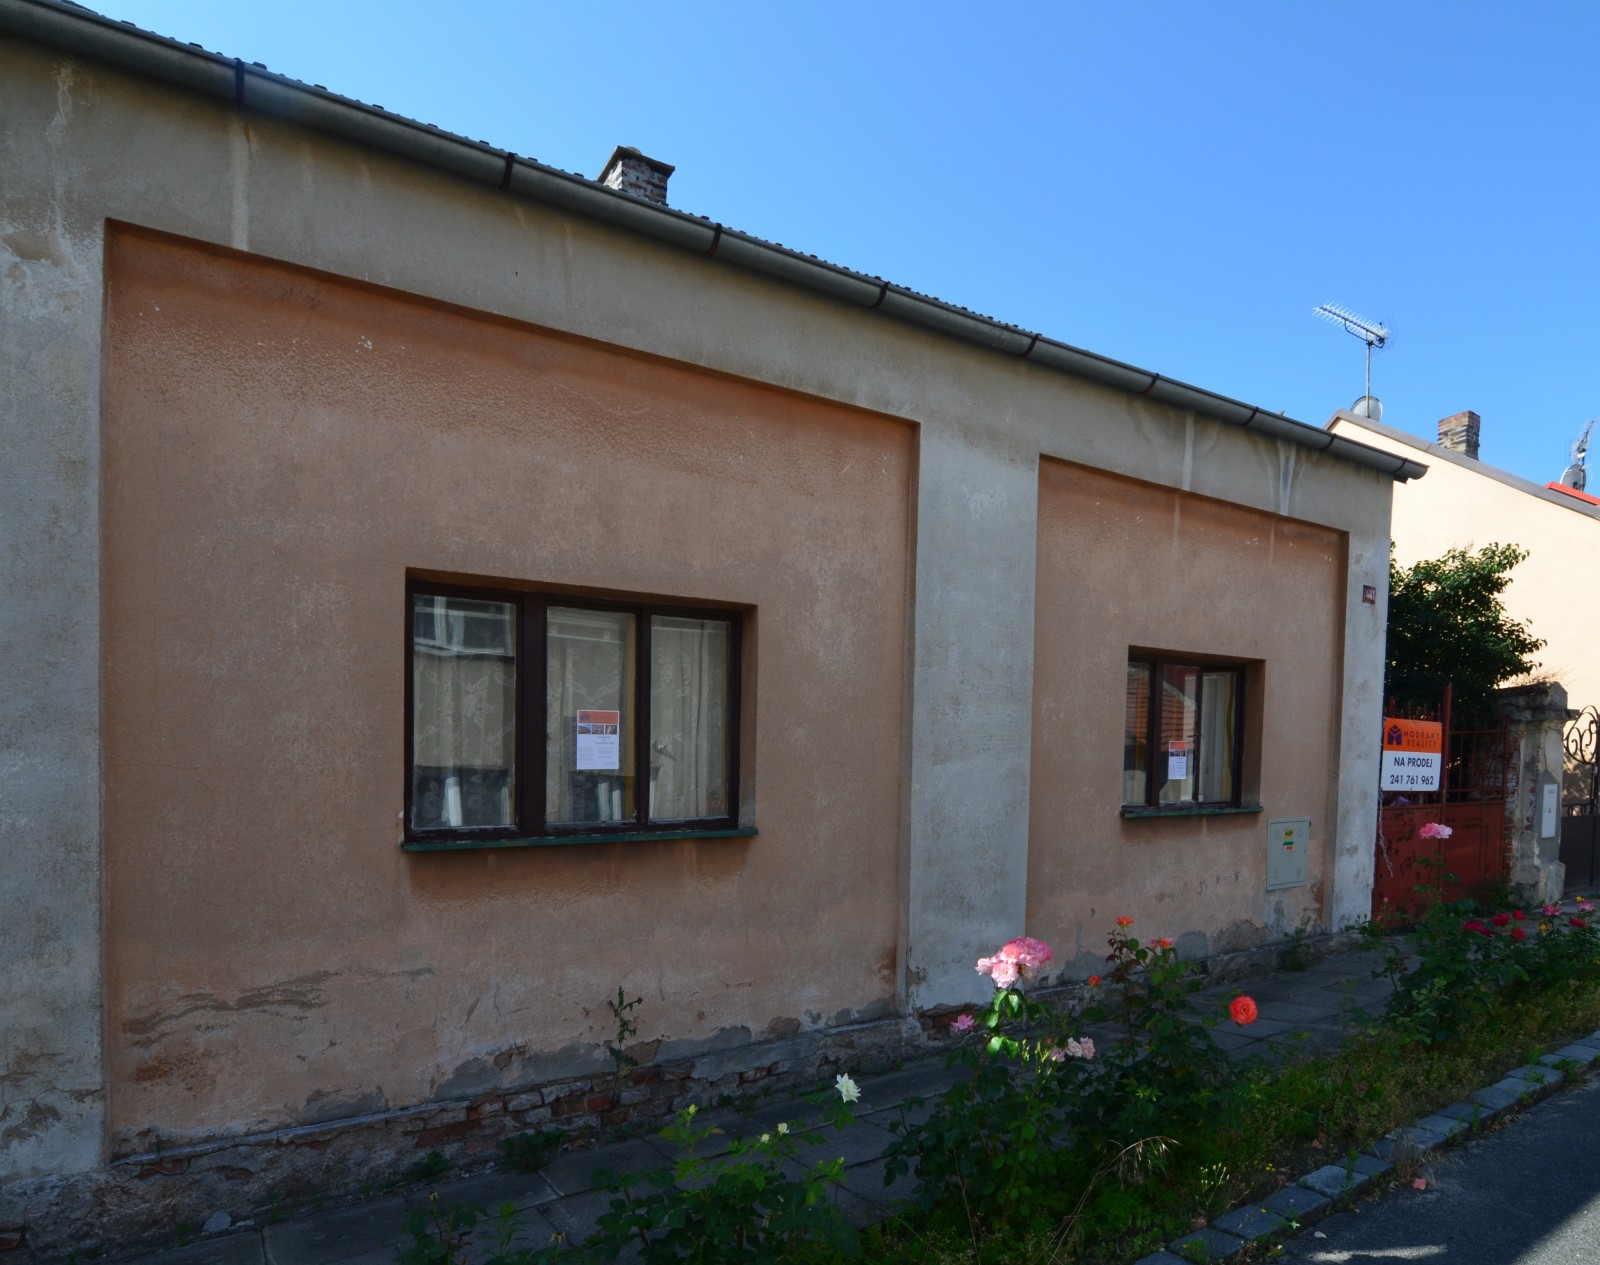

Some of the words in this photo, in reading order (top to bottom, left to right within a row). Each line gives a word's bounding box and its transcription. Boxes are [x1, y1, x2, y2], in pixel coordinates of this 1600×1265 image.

[1407, 739, 1437, 748] REALITY
[1394, 757, 1405, 767] NA
[1407, 757, 1432, 768] PRODEJ
[1390, 774, 1403, 785] 241
[1406, 775, 1418, 785] 761
[1421, 775, 1434, 785] 962
